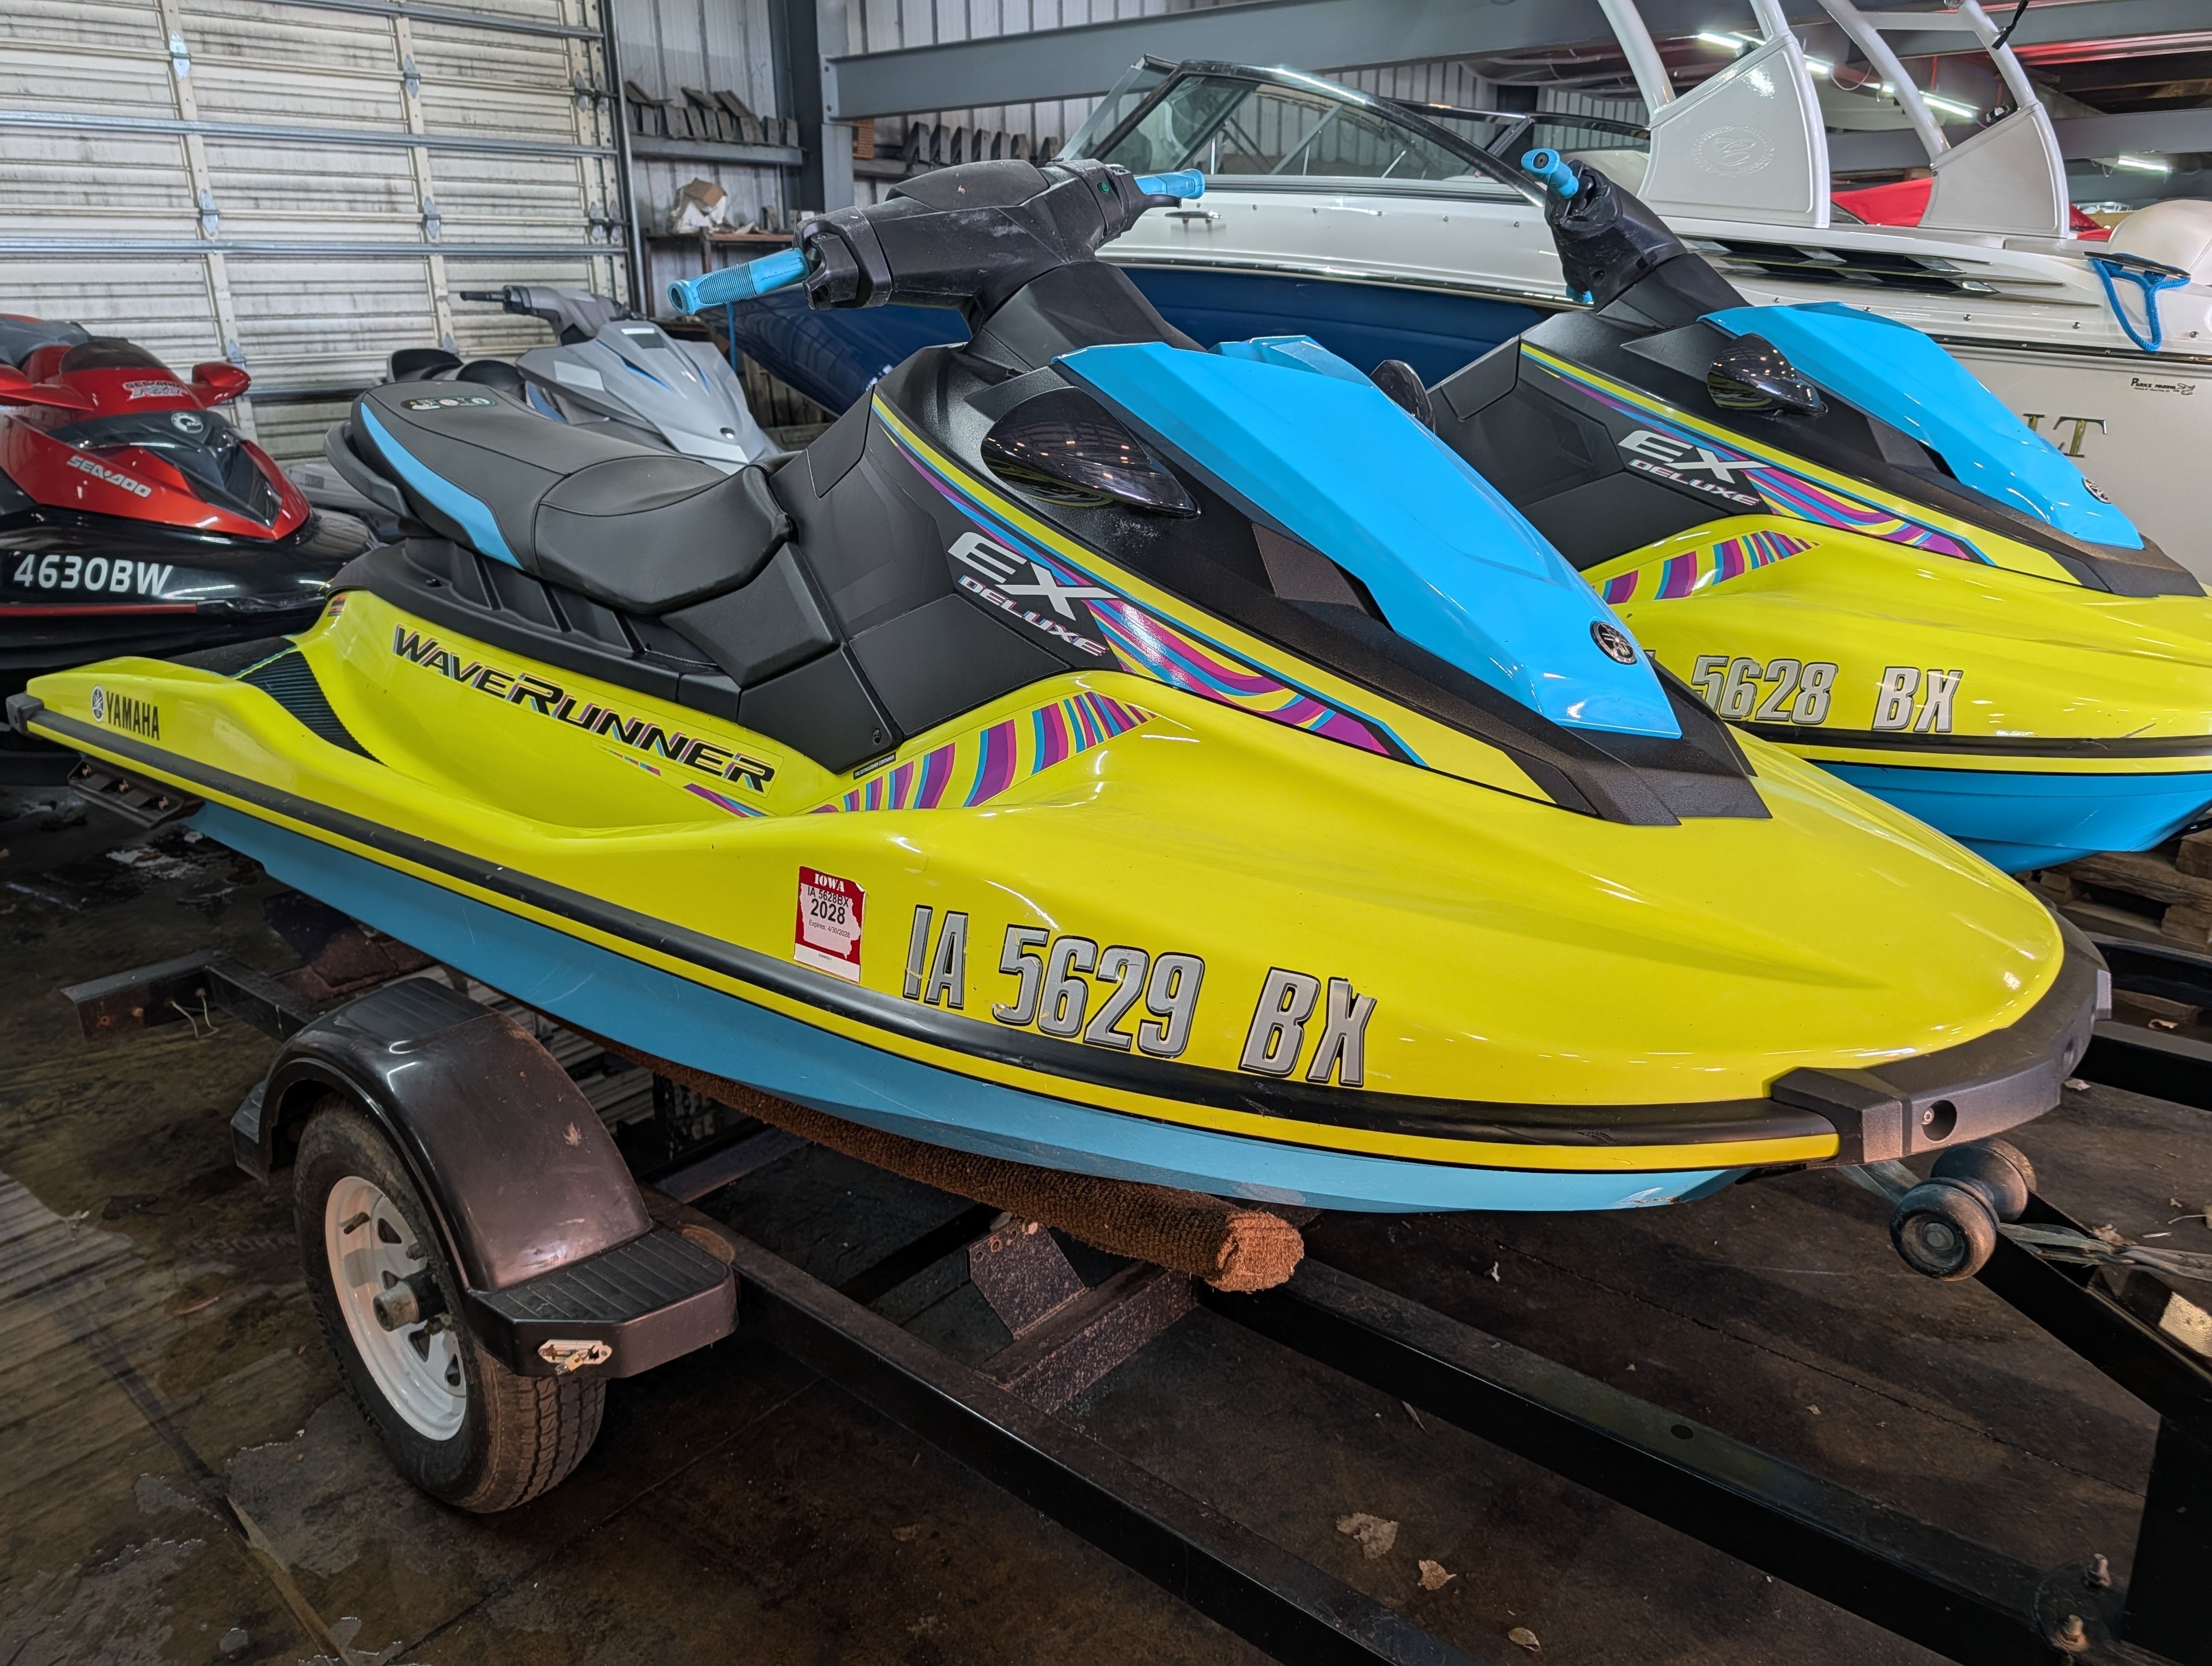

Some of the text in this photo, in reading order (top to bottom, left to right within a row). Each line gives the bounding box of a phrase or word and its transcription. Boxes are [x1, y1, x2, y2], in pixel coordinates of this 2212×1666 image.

[1618, 430, 1771, 484] EX
[1628, 458, 1762, 506] DELUXE
[13, 554, 173, 596] 4630BW
[948, 531, 1120, 621] EX
[957, 575, 1110, 657] DELUXE
[106, 691, 160, 740] YAMAHA
[392, 624, 775, 793] WAVERUNNER
[1690, 655, 1964, 734] 5628 BX
[807, 886, 850, 908] IA 5628BX
[814, 873, 845, 892] IOWA
[808, 919, 851, 938] Expires: 4/30/2028
[810, 898, 846, 925] 2028
[902, 904, 1377, 1088] IA 5629 BX
